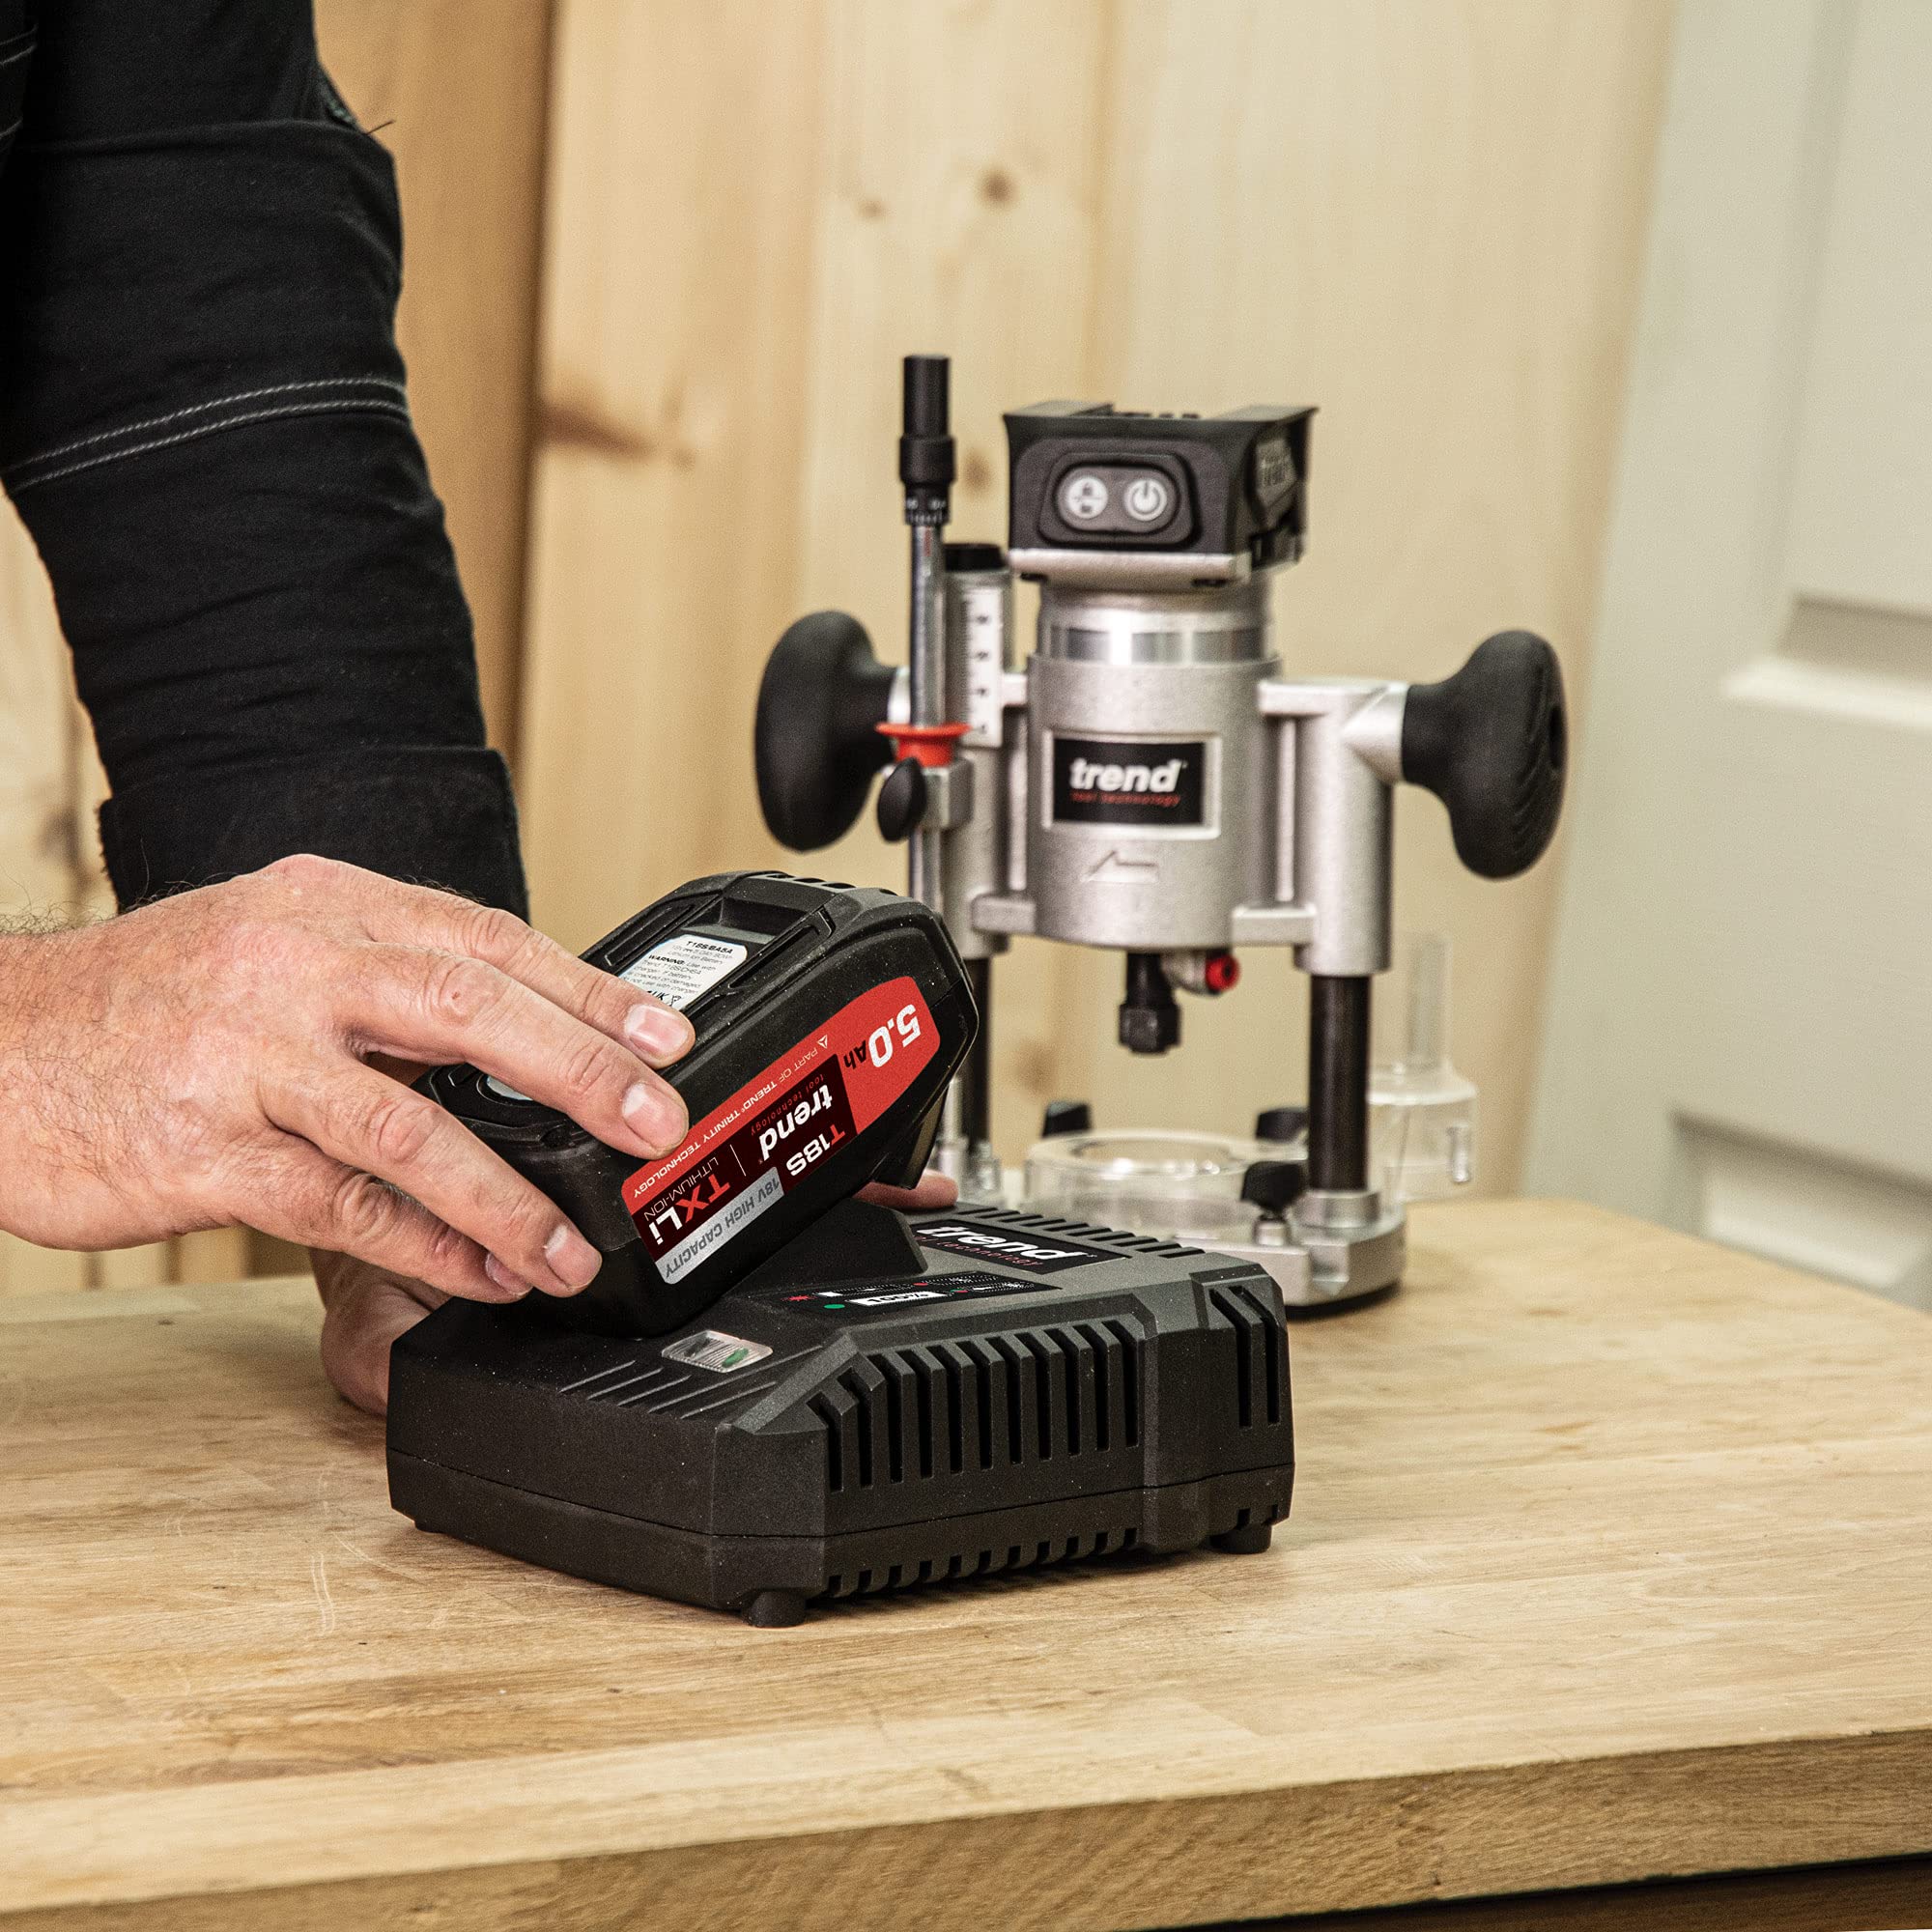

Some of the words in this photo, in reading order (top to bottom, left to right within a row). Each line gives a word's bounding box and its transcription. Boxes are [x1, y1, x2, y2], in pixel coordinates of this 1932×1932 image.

[1069, 758, 1182, 792] trend
[779, 1069, 792, 1083] OF
[794, 1047, 818, 1071] PART
[702, 1110, 742, 1143] TRINITY
[751, 1091, 804, 1136] technology
[759, 1085, 833, 1161] trend
[786, 1123, 845, 1177] T18S
[634, 1141, 701, 1198] TECHNOLOGY
[643, 1156, 720, 1222] LITHIUM-ION
[758, 1178, 780, 1203] 18V
[648, 1174, 731, 1245] TXLi
[724, 1196, 754, 1228] HIGH
[666, 1223, 723, 1278] CAPACITY
[917, 1226, 1088, 1260] trend
[937, 1241, 1044, 1266] technology
